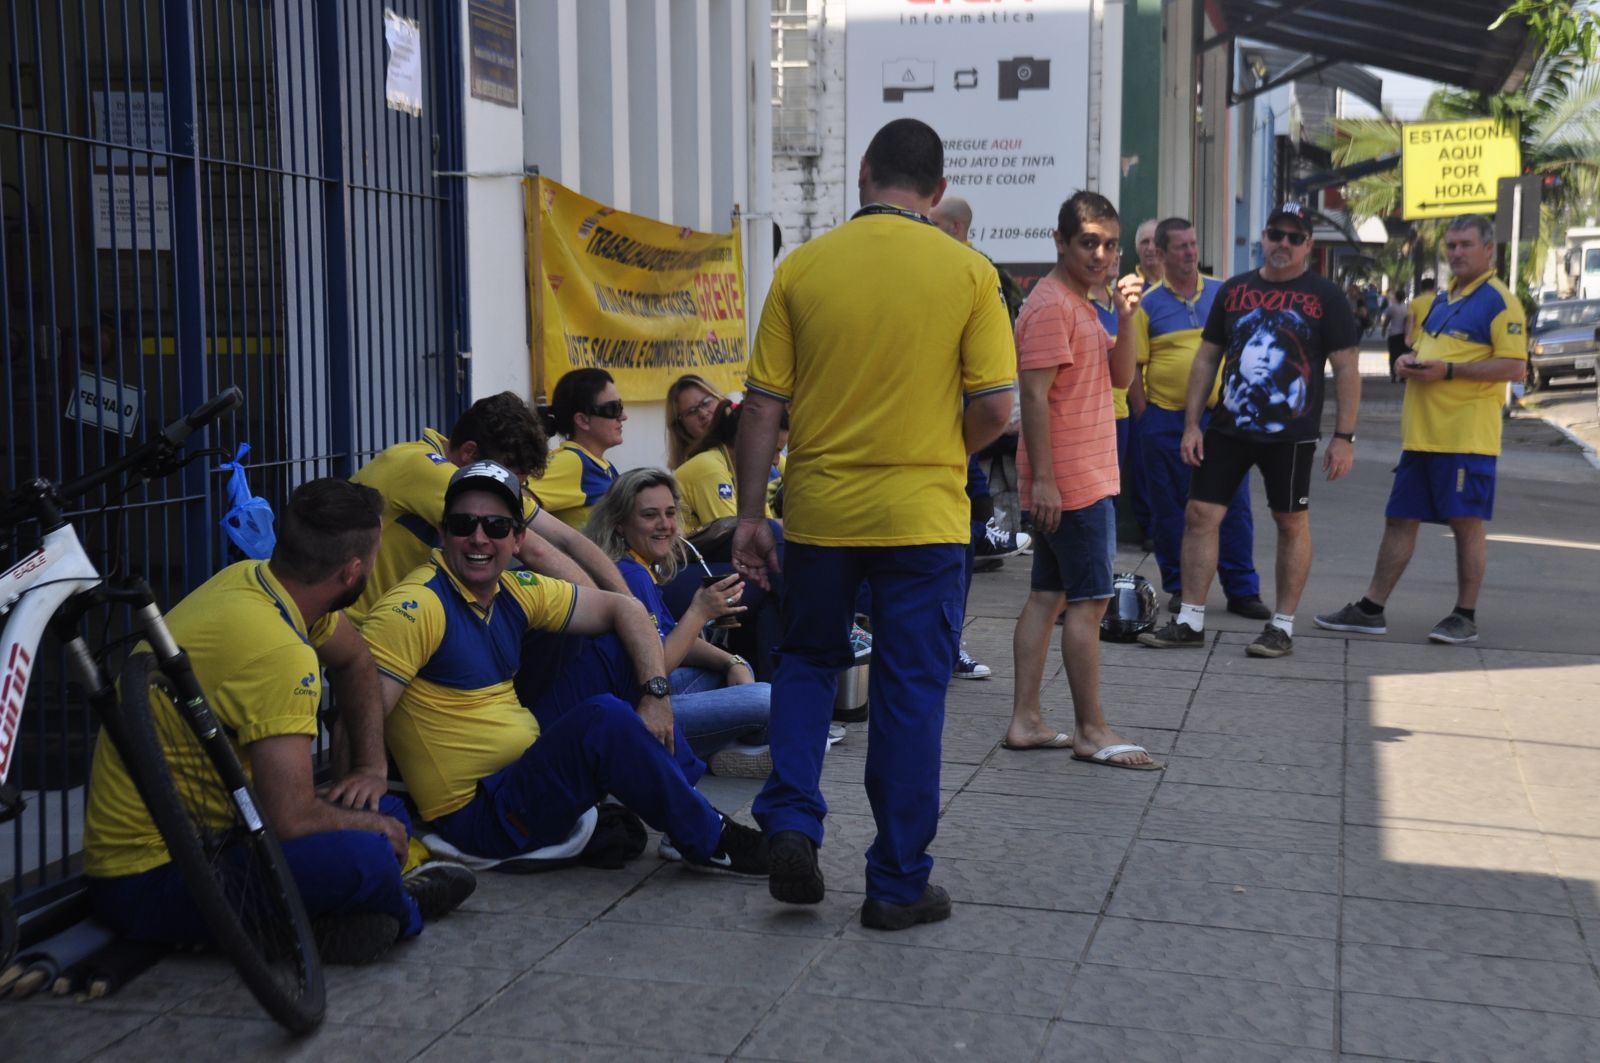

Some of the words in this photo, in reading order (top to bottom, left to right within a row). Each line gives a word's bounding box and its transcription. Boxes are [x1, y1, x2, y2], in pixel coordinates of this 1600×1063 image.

[943, 139, 988, 151] RREGUE
[991, 138, 1023, 150] AQUI
[1438, 145, 1483, 161] AQUI
[970, 156, 998, 168] JATO
[1001, 156, 1018, 168] DE
[1022, 155, 1055, 167] TINTA
[985, 174, 993, 185] E
[996, 173, 1036, 185] COLOR
[1441, 165, 1480, 180] POR
[1434, 183, 1487, 199] HORA
[989, 227, 1054, 240] 2109-6660
[693, 271, 744, 321] GREVE
[590, 335, 635, 369] SALARIAL
[80, 390, 133, 417] FECHAO
[13, 554, 48, 580] EAGLE
